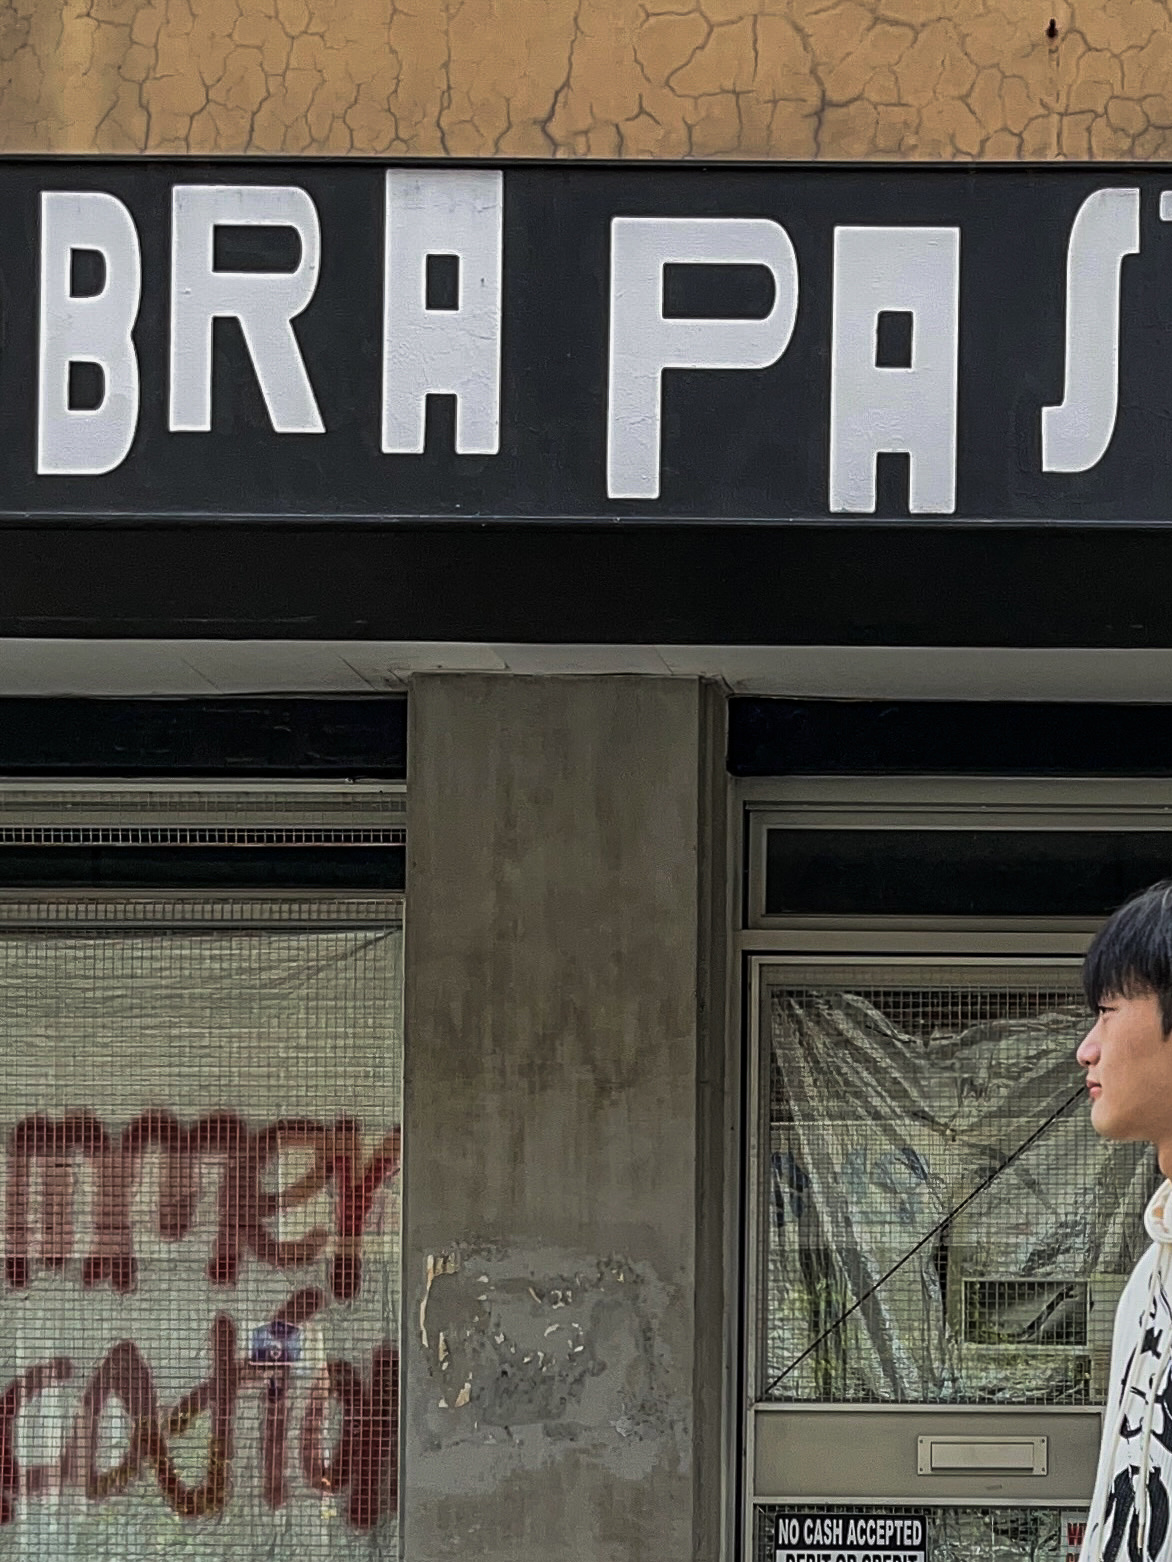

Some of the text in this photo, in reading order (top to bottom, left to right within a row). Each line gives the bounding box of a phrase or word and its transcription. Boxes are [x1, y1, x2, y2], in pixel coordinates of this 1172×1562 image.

[37, 169, 503, 475] BRA
[778, 1518, 922, 1547] NO CASH ACCEPTED
